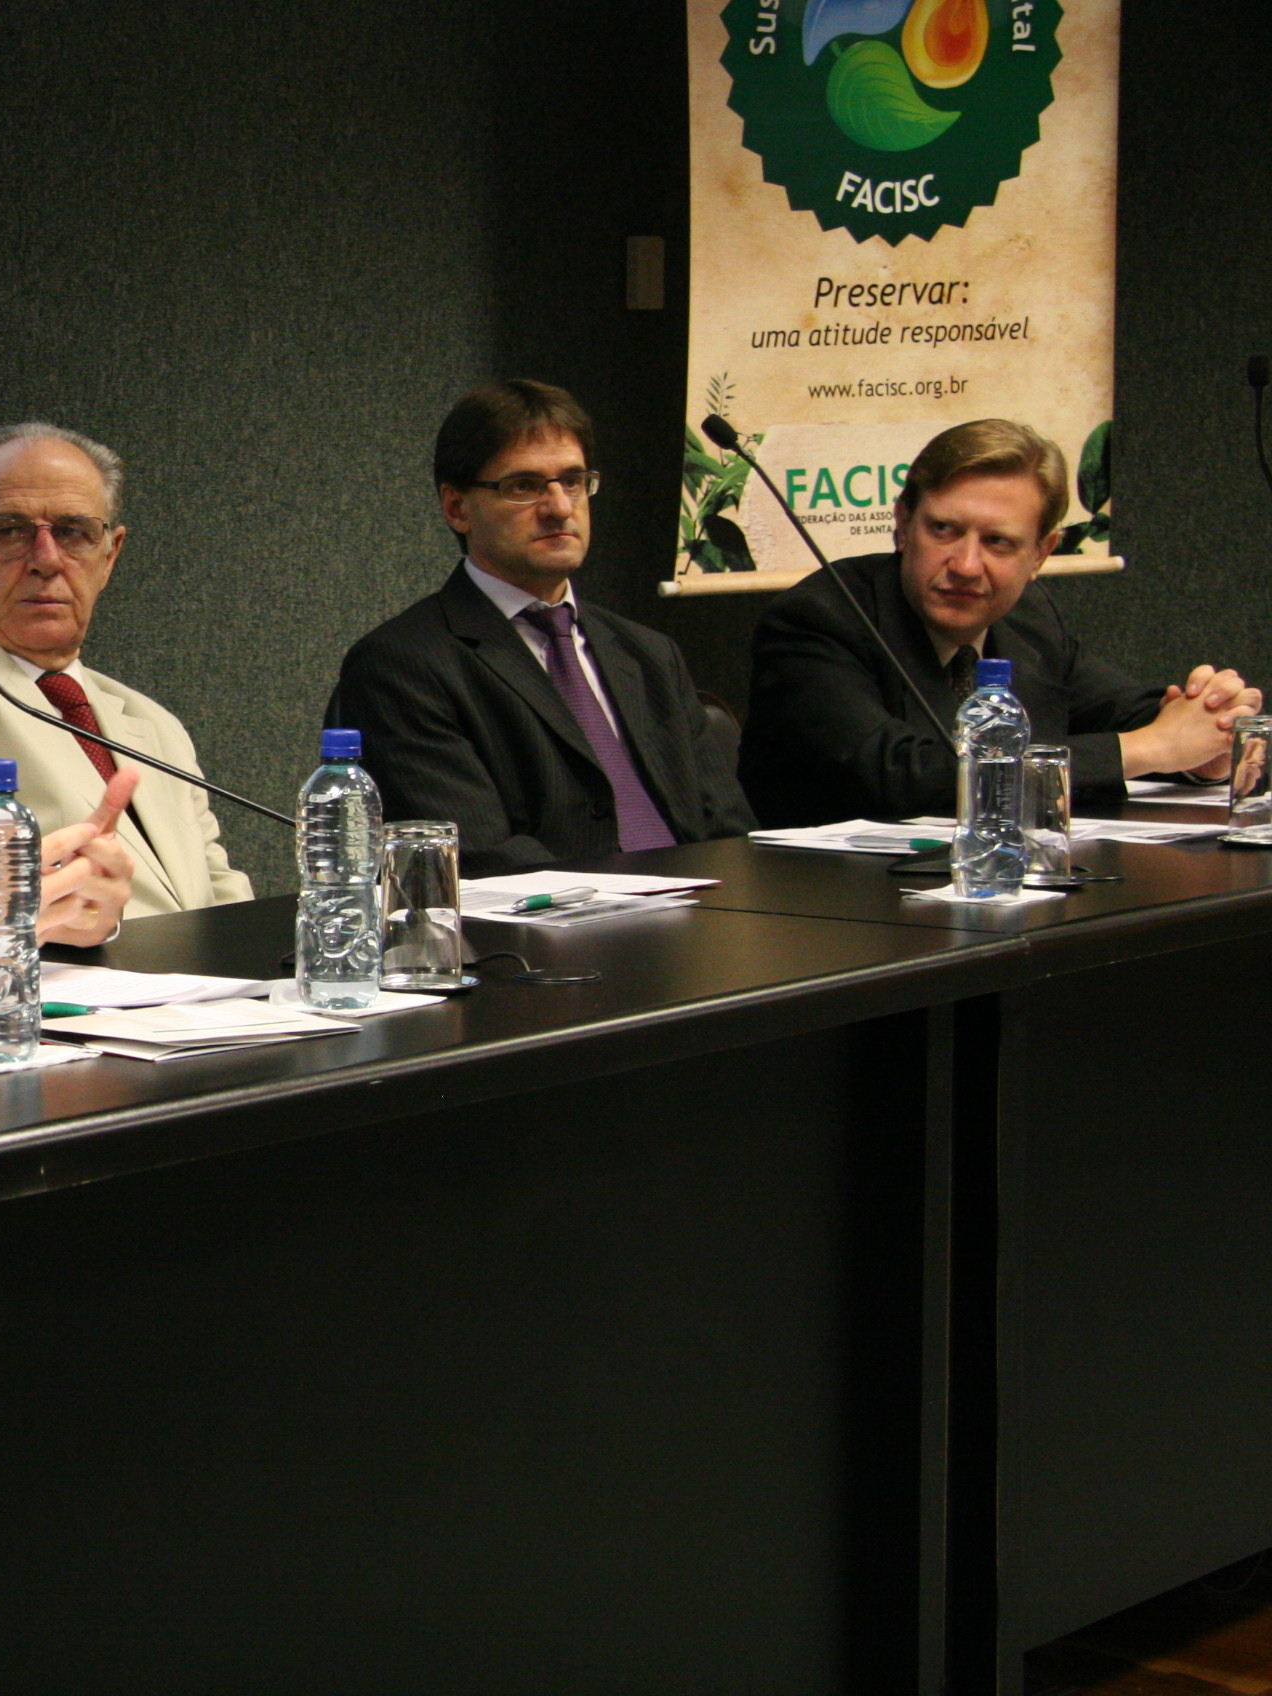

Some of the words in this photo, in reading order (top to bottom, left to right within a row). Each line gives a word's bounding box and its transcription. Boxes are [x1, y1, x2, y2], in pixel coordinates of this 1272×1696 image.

[1012, 0, 1036, 52] tal
[835, 170, 940, 214] FACISC
[813, 276, 971, 309] Preservar:
[751, 328, 801, 349] uma
[808, 321, 892, 347] atitude
[900, 316, 1030, 349] responsável
[808, 376, 969, 400] www.facisc.org.br
[797, 512, 846, 525] EDERAÇÃO
[848, 512, 867, 522] DAS
[869, 511, 895, 521] ASSO
[850, 526, 862, 535] DE
[864, 525, 894, 535] SANTA
